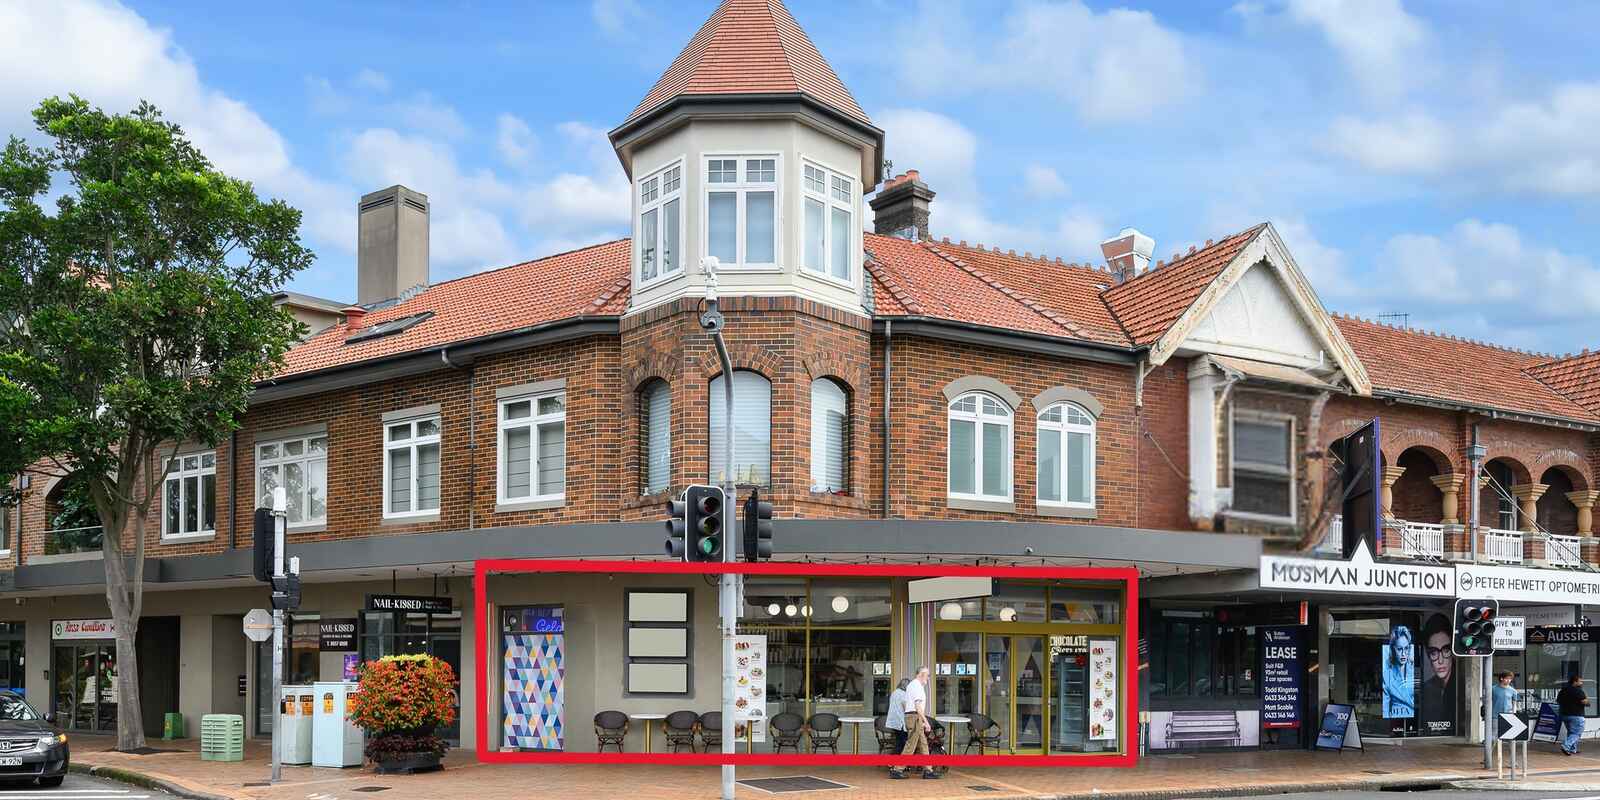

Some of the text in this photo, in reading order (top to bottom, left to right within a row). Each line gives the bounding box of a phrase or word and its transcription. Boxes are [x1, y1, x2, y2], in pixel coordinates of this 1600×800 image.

[1271, 562, 1447, 590] MOSMAN JUNCTION
[1475, 576, 1600, 594] PETER HEWETT OPTOMETRI
[373, 598, 421, 609] NAIL-KISSED
[320, 623, 355, 633] NAIL-KISSED
[1505, 629, 1513, 637] TO
[1547, 628, 1590, 641] Aussie
[1050, 635, 1088, 647] CHOCOLATE
[1495, 638, 1523, 646] PEDESTRIANS
[1265, 646, 1297, 659] LEASE
[1278, 687, 1299, 695] Kingston
[1337, 712, 1349, 720] 100
